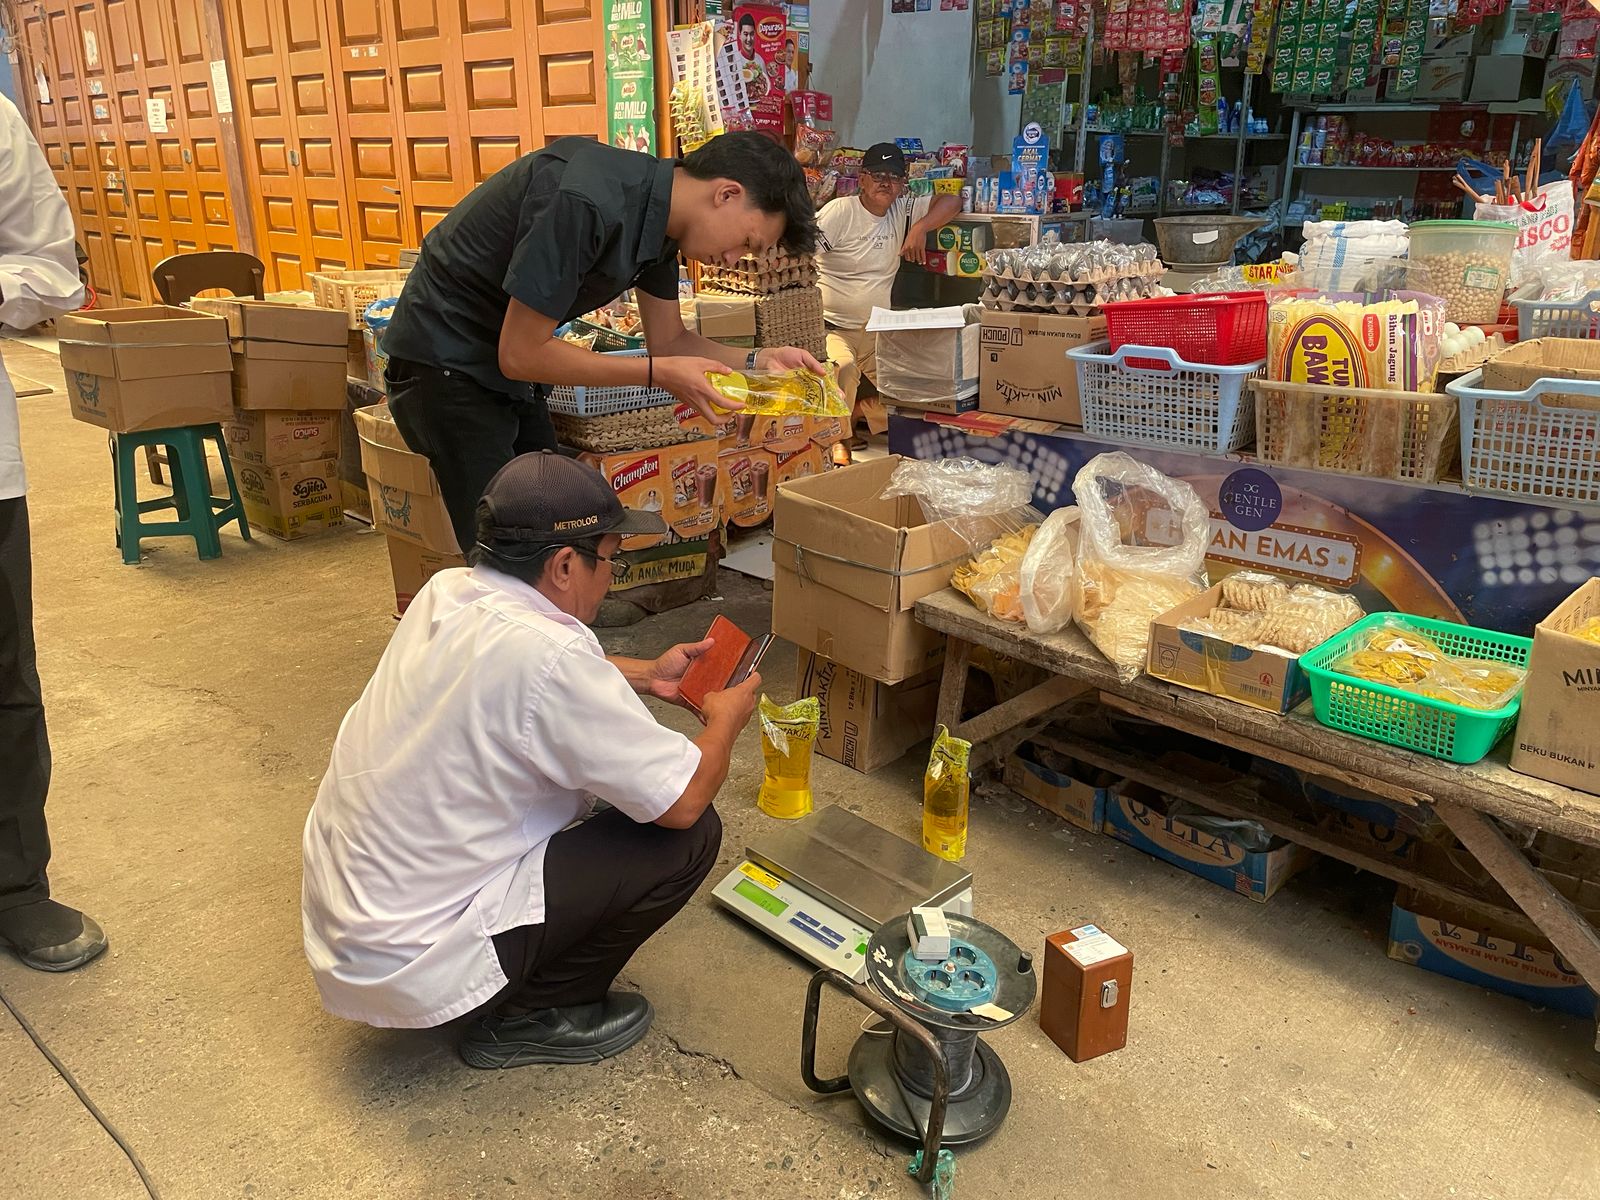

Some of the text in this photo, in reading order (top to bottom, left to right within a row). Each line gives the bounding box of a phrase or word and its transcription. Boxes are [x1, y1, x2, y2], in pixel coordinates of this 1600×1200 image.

[621, 2, 642, 19] MILO
[624, 101, 647, 119] MILO
[1515, 214, 1570, 249] ISCO
[1249, 266, 1272, 280] STAR
[982, 327, 1008, 342] POUCH
[1365, 315, 1375, 347] EKONOMIS
[1387, 314, 1398, 383] Bihun Jagung
[996, 379, 1063, 405] MINAKITA
[294, 426, 319, 438] SunCo
[613, 459, 658, 491] Champion
[292, 477, 328, 499] Sajiku
[292, 493, 333, 509] SERBAGUNA
[1235, 507, 1263, 519] GEN
[554, 515, 598, 531] METROLOGI
[1211, 527, 1330, 568] AN EMAS
[638, 565, 665, 581] ANAK
[668, 560, 696, 575] MUDA
[1519, 743, 1547, 758] BEKU
[1549, 751, 1586, 769] BUKAN
[1435, 938, 1482, 959] KEMASAN
[1484, 951, 1519, 968] DALAM
[1521, 963, 1559, 979] MINUM
